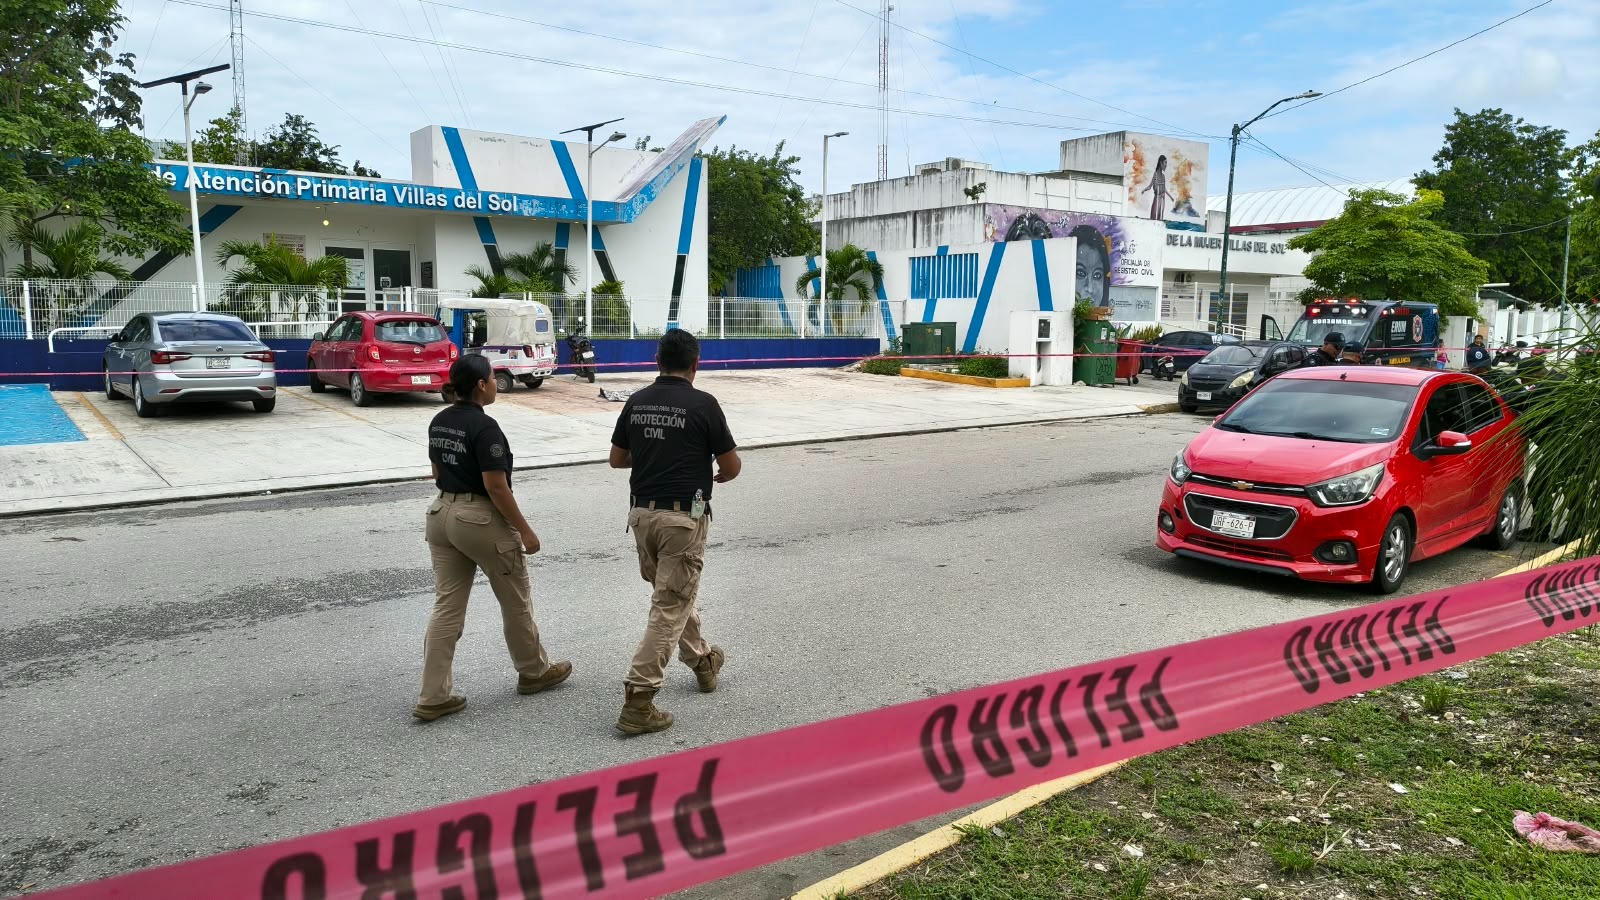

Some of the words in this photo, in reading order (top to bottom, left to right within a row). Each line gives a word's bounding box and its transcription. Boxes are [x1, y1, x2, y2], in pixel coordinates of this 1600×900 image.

[184, 168, 290, 195] Atención
[297, 177, 387, 202] Primaria
[392, 185, 448, 207] Villas
[454, 191, 482, 210] del
[488, 193, 518, 212] Sol
[1166, 233, 1179, 247] DE
[1179, 234, 1193, 248] LA
[1193, 235, 1222, 250] MUJER
[1228, 238, 1253, 252] ILLAS
[1253, 241, 1269, 254] DEL
[1270, 242, 1286, 255] SOL
[1114, 266, 1138, 275] REGISTRO
[1140, 268, 1154, 276] CIVIL
[670, 406, 687, 415] TODOS
[630, 413, 686, 430] PROTECCIÓN
[644, 427, 666, 440] CIVIL
[1283, 596, 1457, 694] PELIGRO
[920, 656, 1179, 793] PELIGRO
